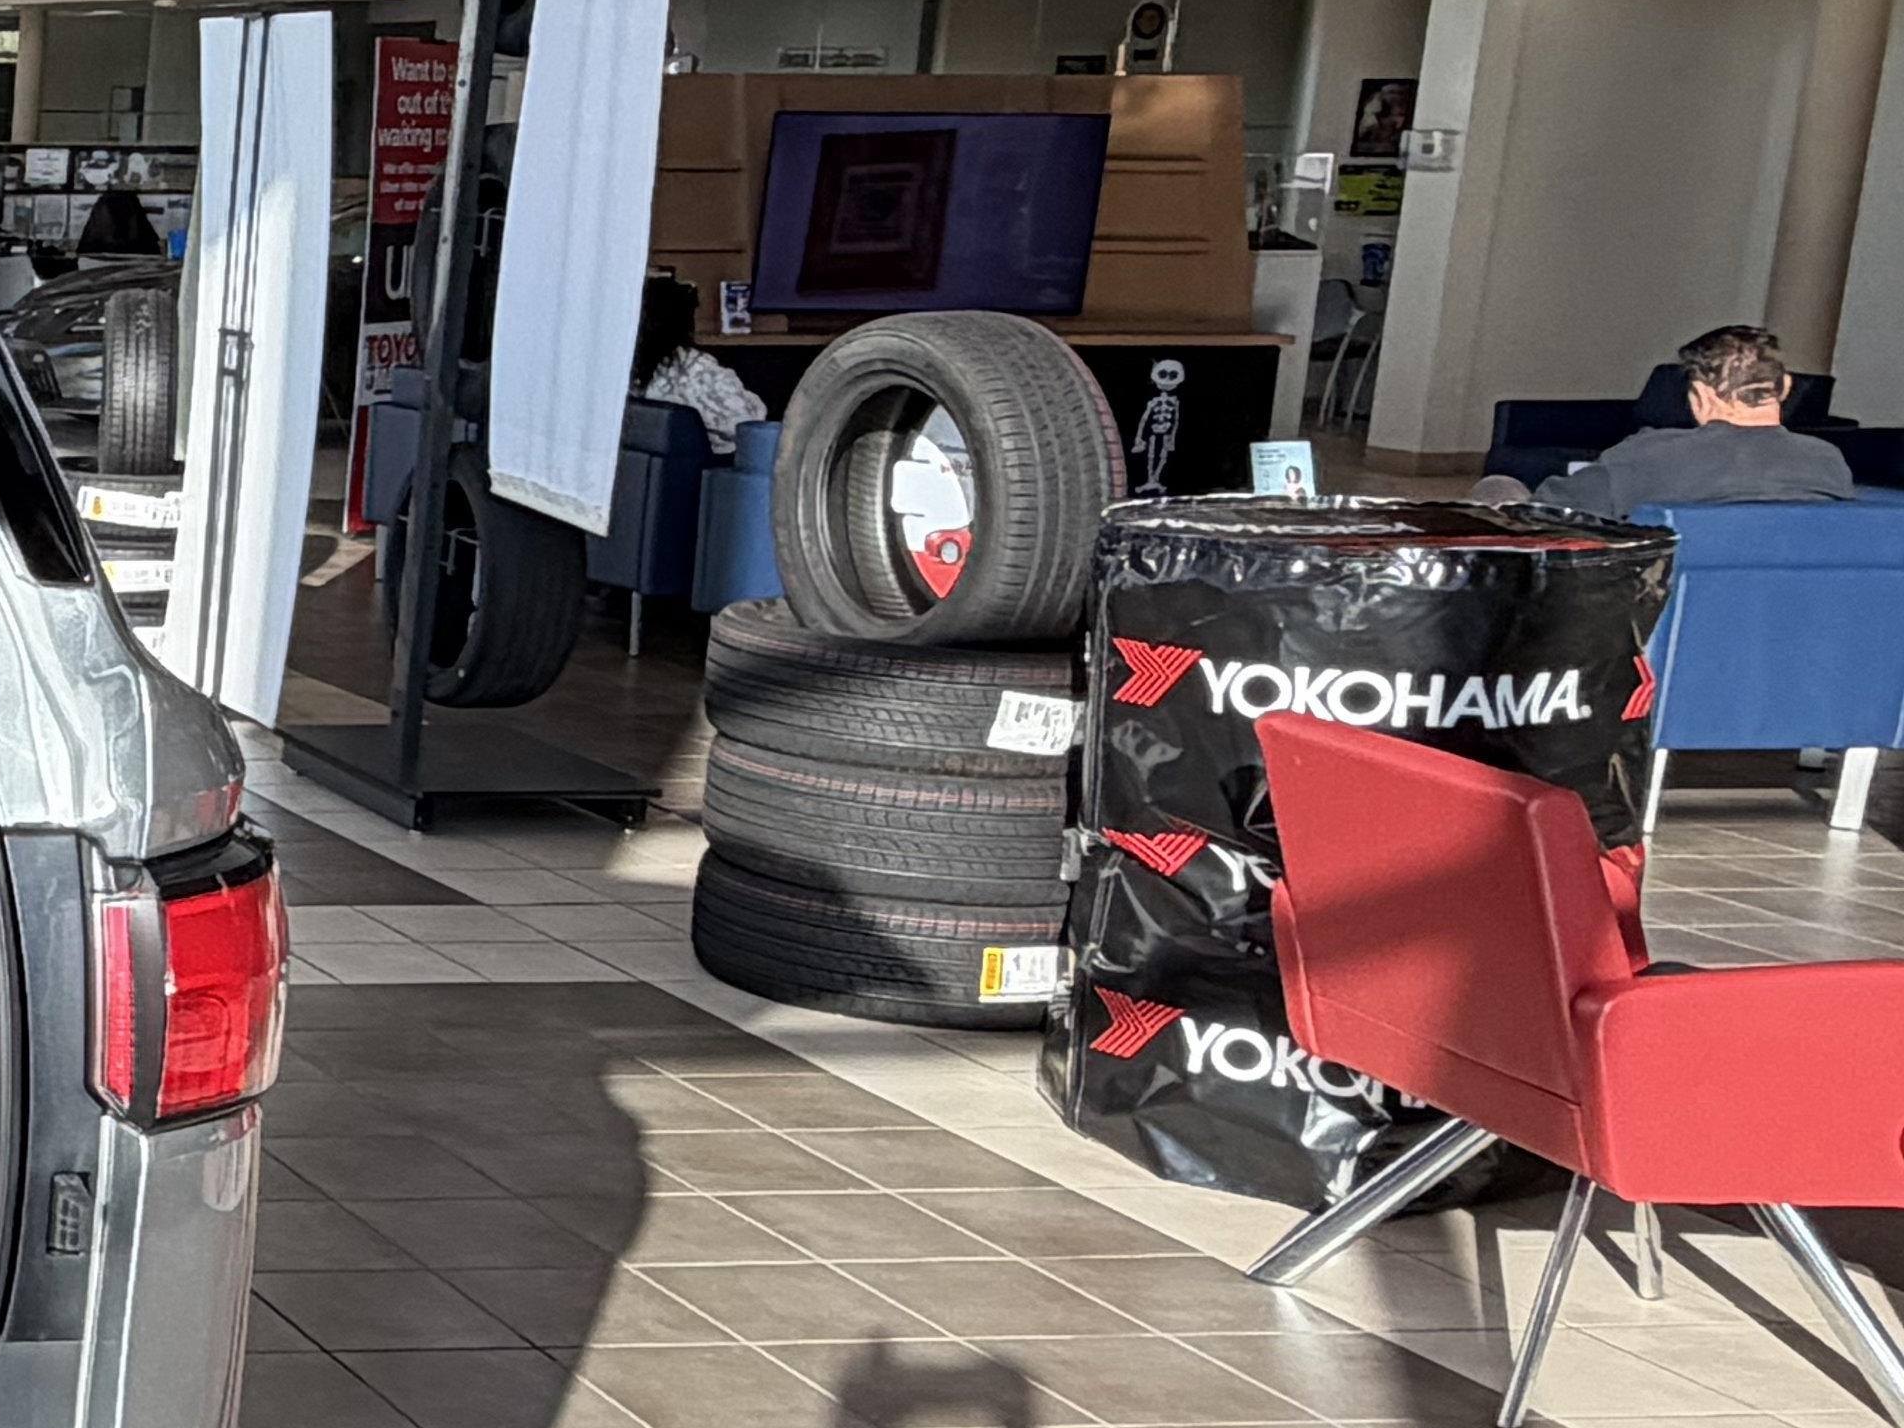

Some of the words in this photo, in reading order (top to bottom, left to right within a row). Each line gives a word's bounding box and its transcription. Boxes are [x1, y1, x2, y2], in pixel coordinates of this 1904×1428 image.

[392, 57, 430, 82] Want
[433, 60, 447, 82] to
[397, 92, 422, 114] out
[424, 89, 439, 114] of
[378, 122, 432, 152] waiting
[365, 333, 418, 367] TOYO
